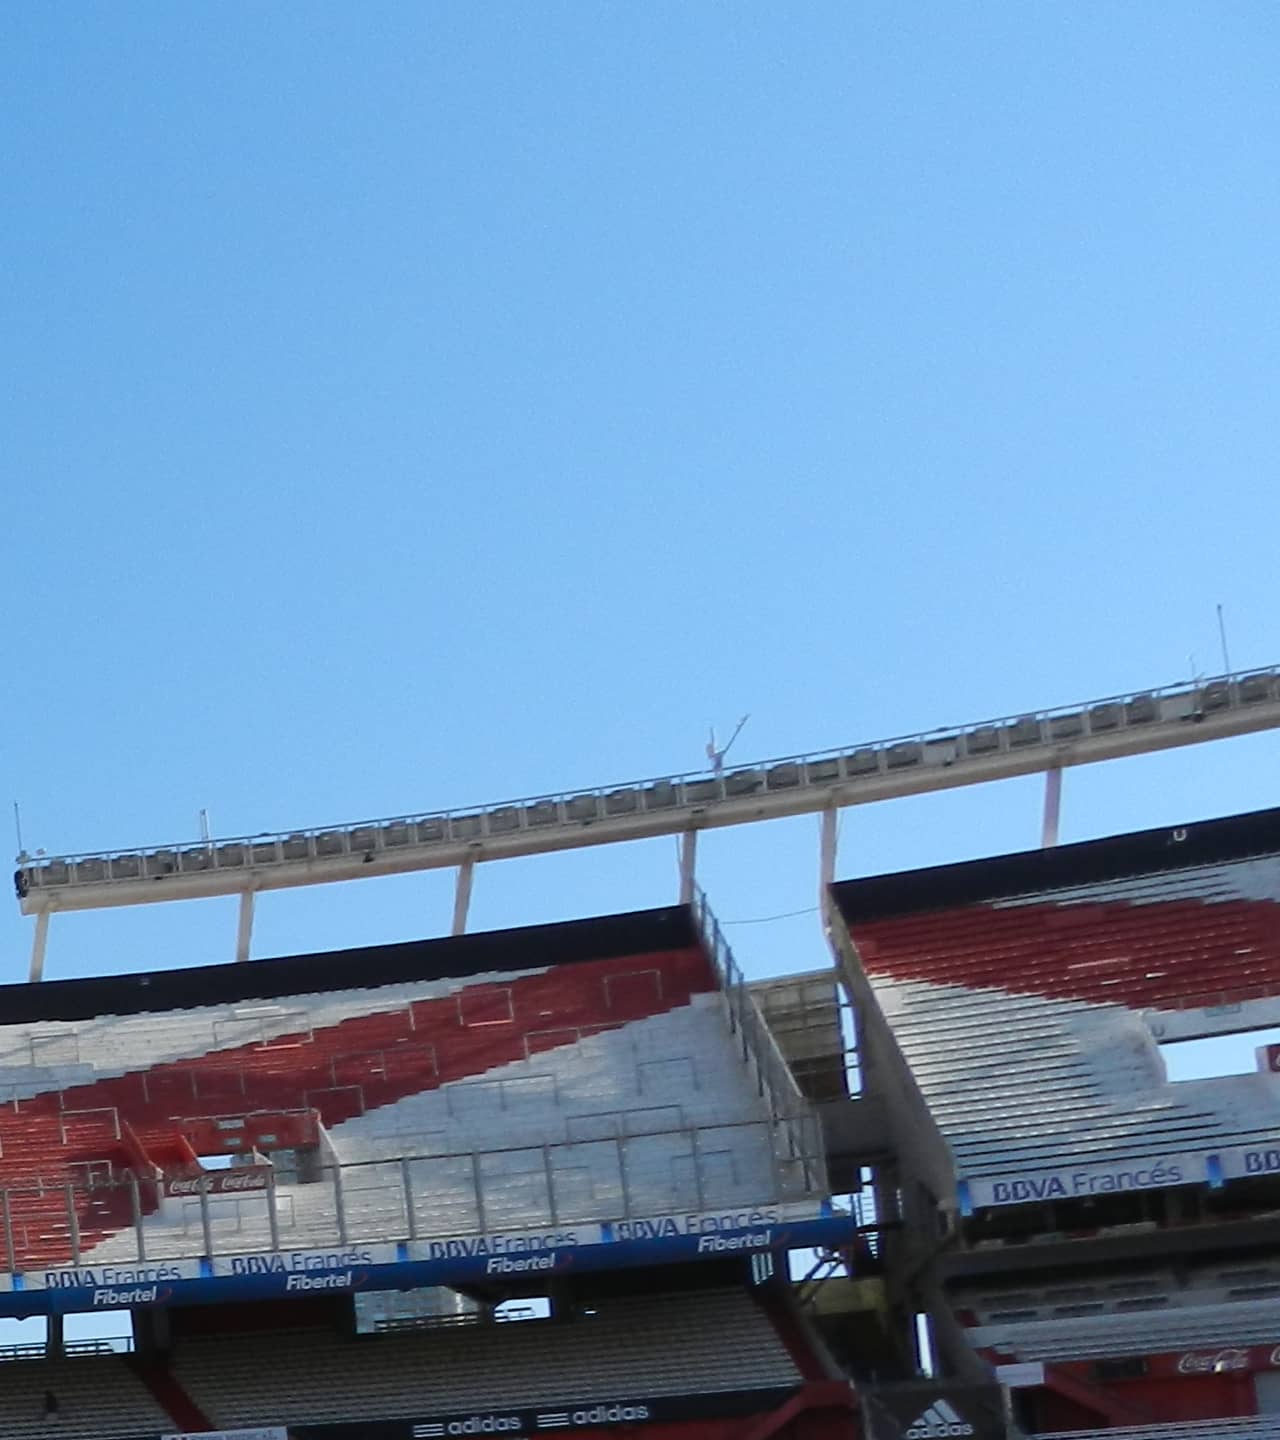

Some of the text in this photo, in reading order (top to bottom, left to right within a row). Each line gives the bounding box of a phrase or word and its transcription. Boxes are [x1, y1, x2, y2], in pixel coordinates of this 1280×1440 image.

[993, 1160, 1183, 1203] BBVA Francés
[697, 1230, 772, 1252] Fibertel
[487, 1252, 556, 1273] Fibertel
[286, 1271, 352, 1290] Fibertel
[94, 1286, 157, 1304] Fibertel
[572, 1404, 649, 1424] adidas
[447, 1415, 521, 1434] adidas
[906, 1422, 975, 1440] adidas
